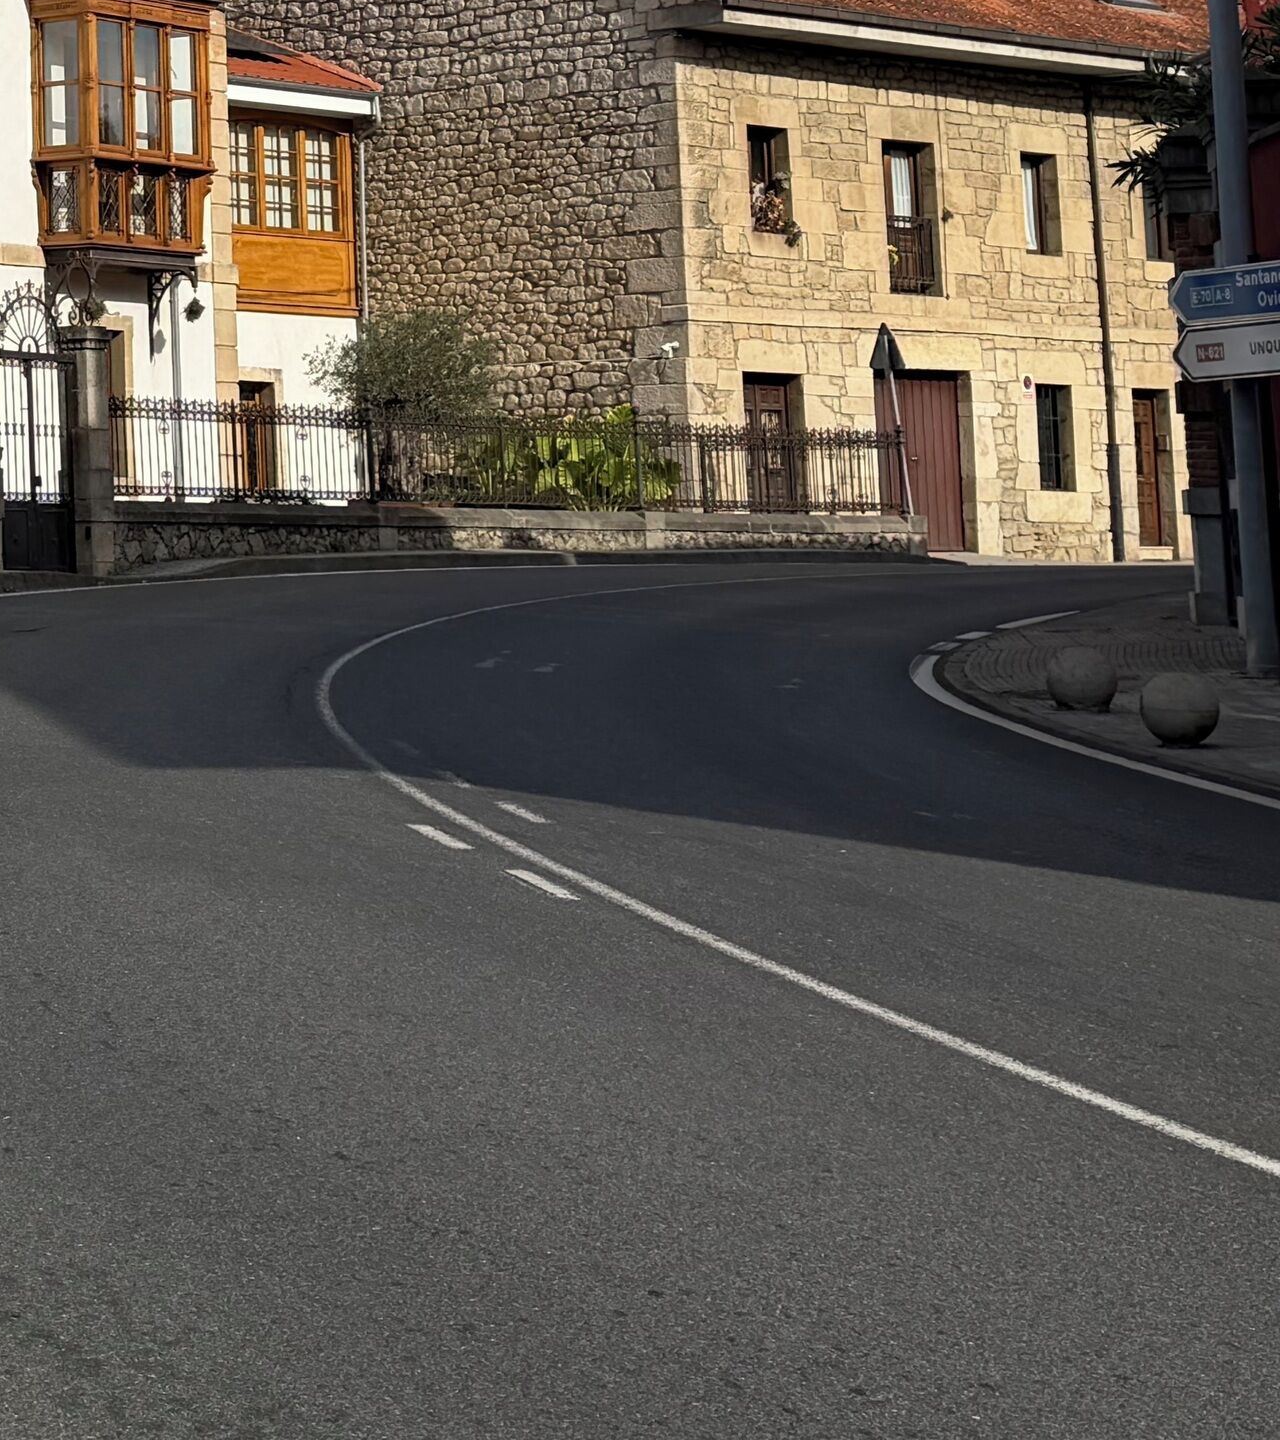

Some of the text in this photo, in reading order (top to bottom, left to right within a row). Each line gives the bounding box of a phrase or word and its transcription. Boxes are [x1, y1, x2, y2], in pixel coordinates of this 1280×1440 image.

[1192, 288, 1231, 304] E-70 A-8
[1197, 345, 1224, 360] N-621
